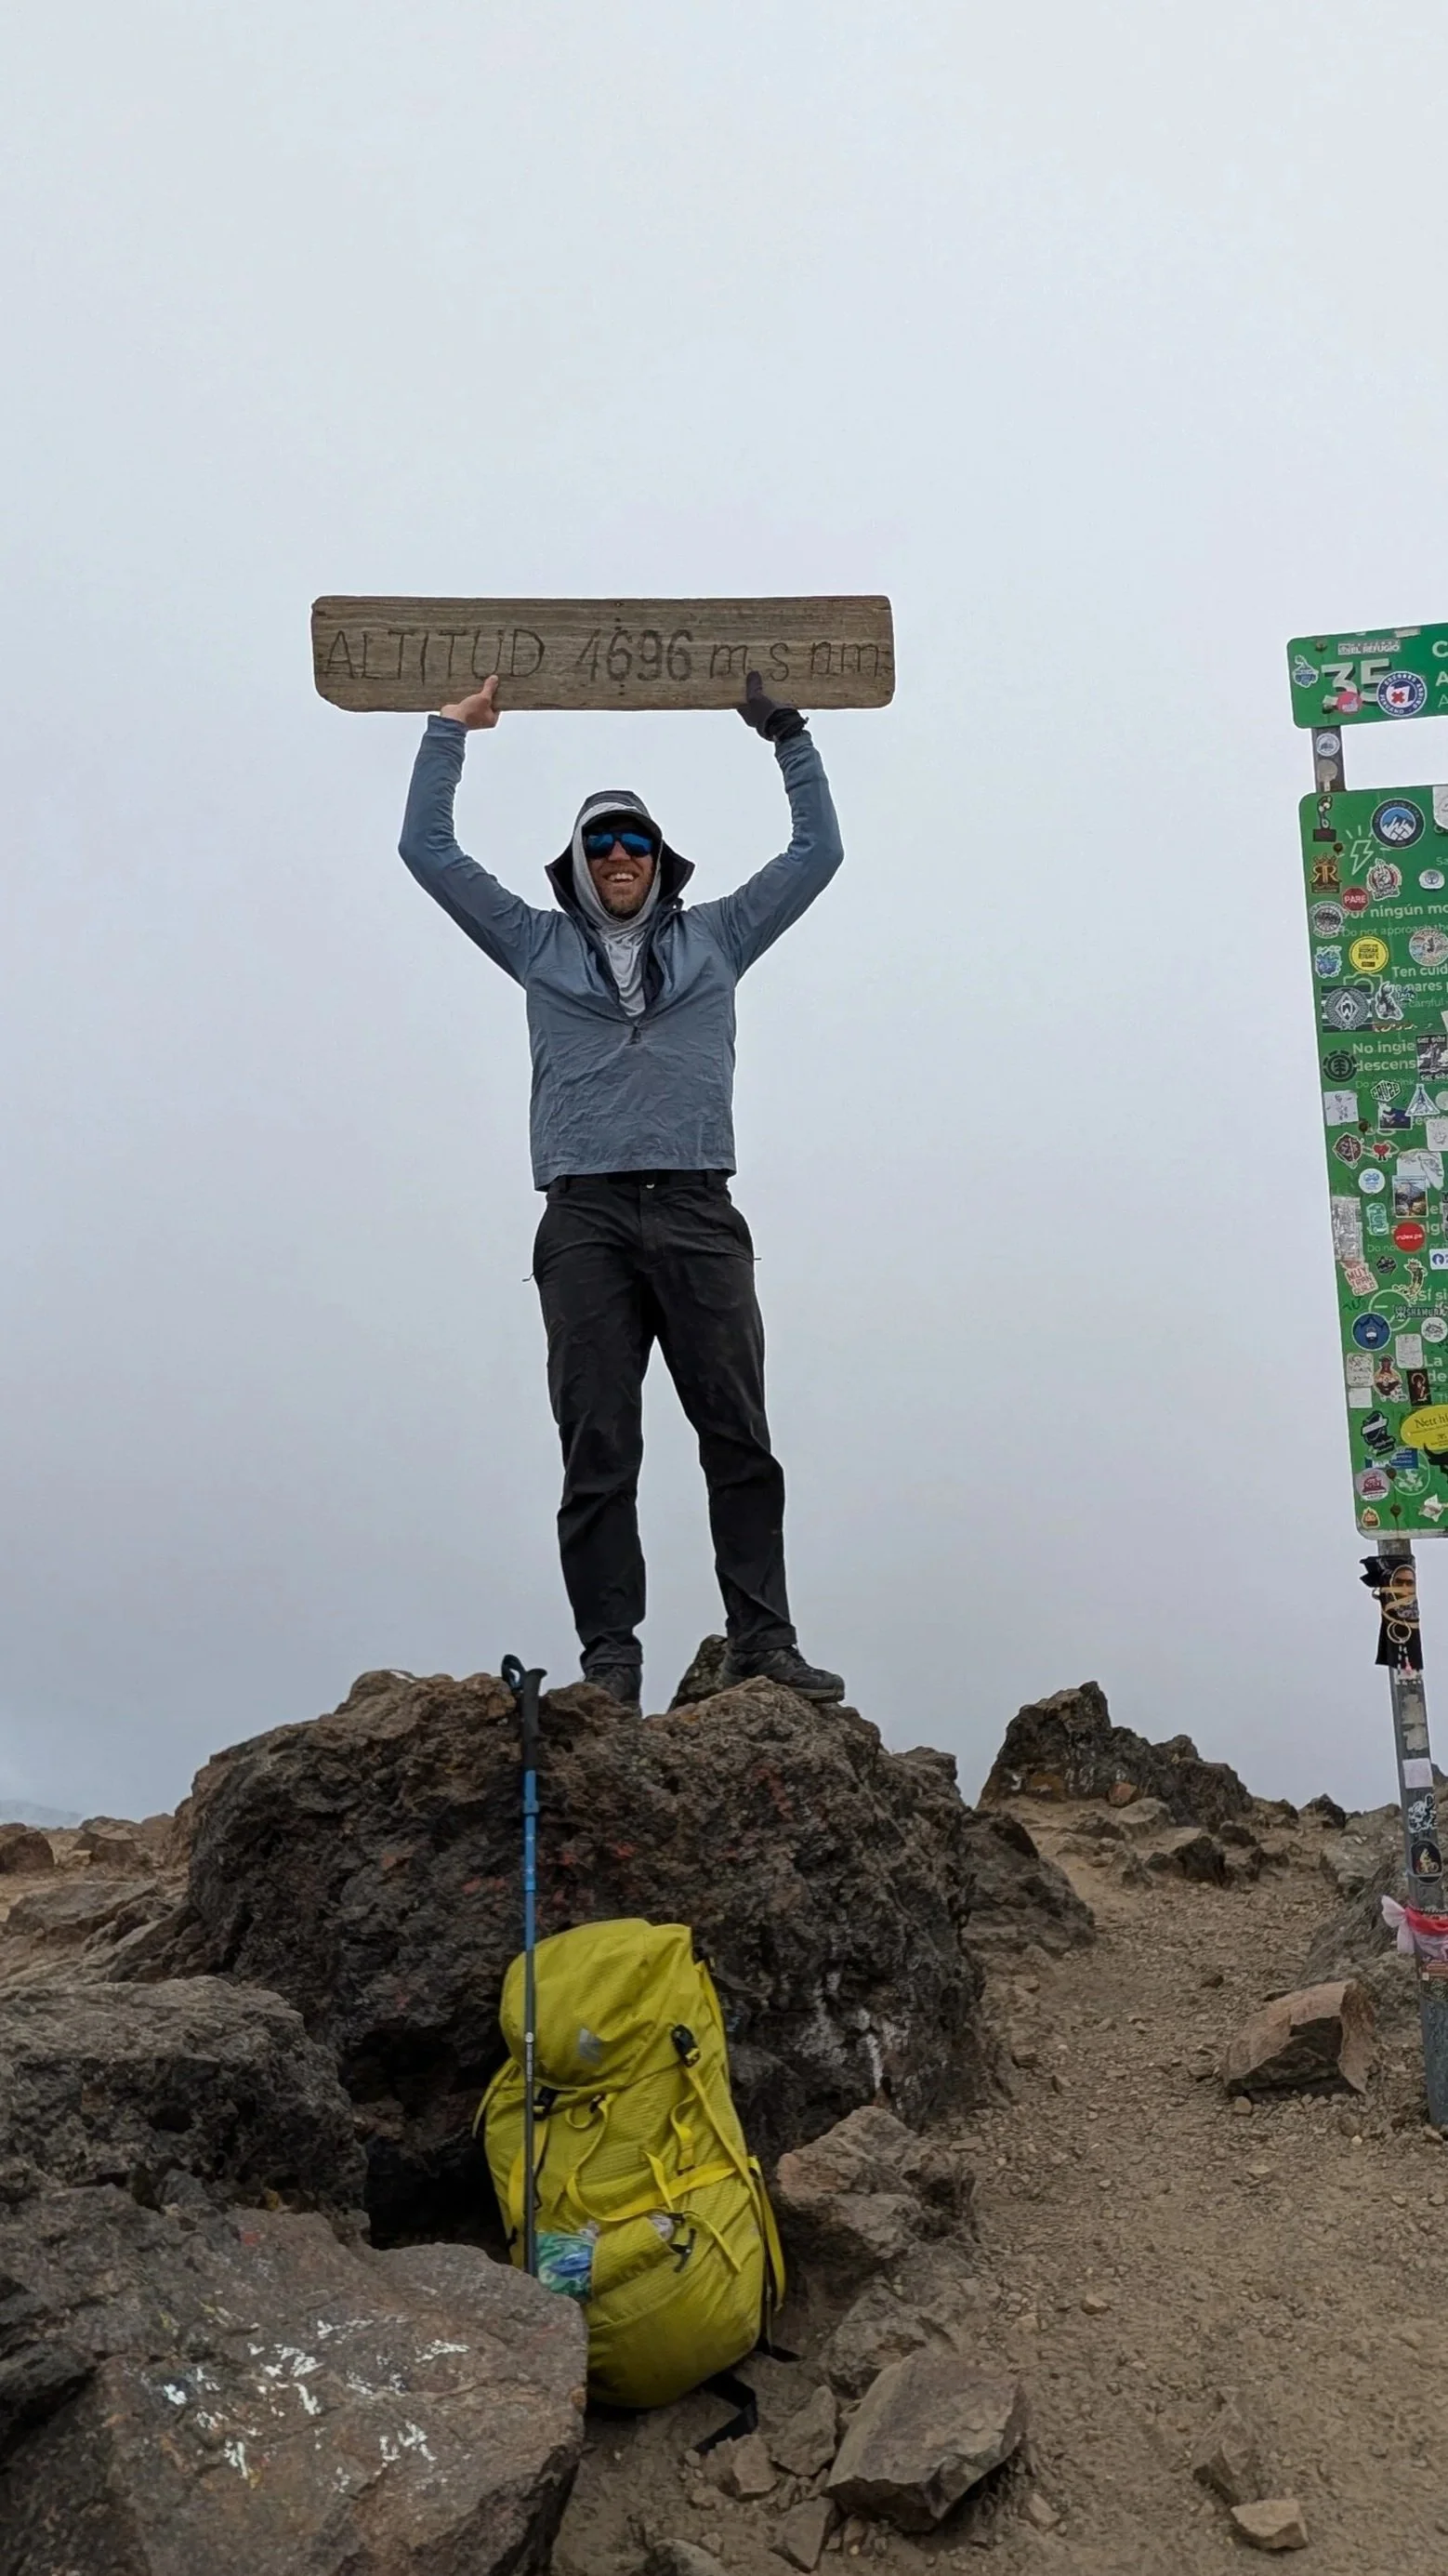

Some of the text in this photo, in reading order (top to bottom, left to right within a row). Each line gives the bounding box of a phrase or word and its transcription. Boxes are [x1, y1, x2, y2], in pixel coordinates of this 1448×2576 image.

[325, 627, 546, 686] ALTITUD
[576, 627, 693, 682] 4696
[1321, 658, 1391, 708] 35
[1344, 894, 1366, 904] PARE
[1370, 904, 1424, 919] ningún
[1391, 966, 1416, 977] Ten
[1352, 1042, 1374, 1054] No
[1424, 1354, 1443, 1367] La
[1428, 1368, 1447, 1382] de
